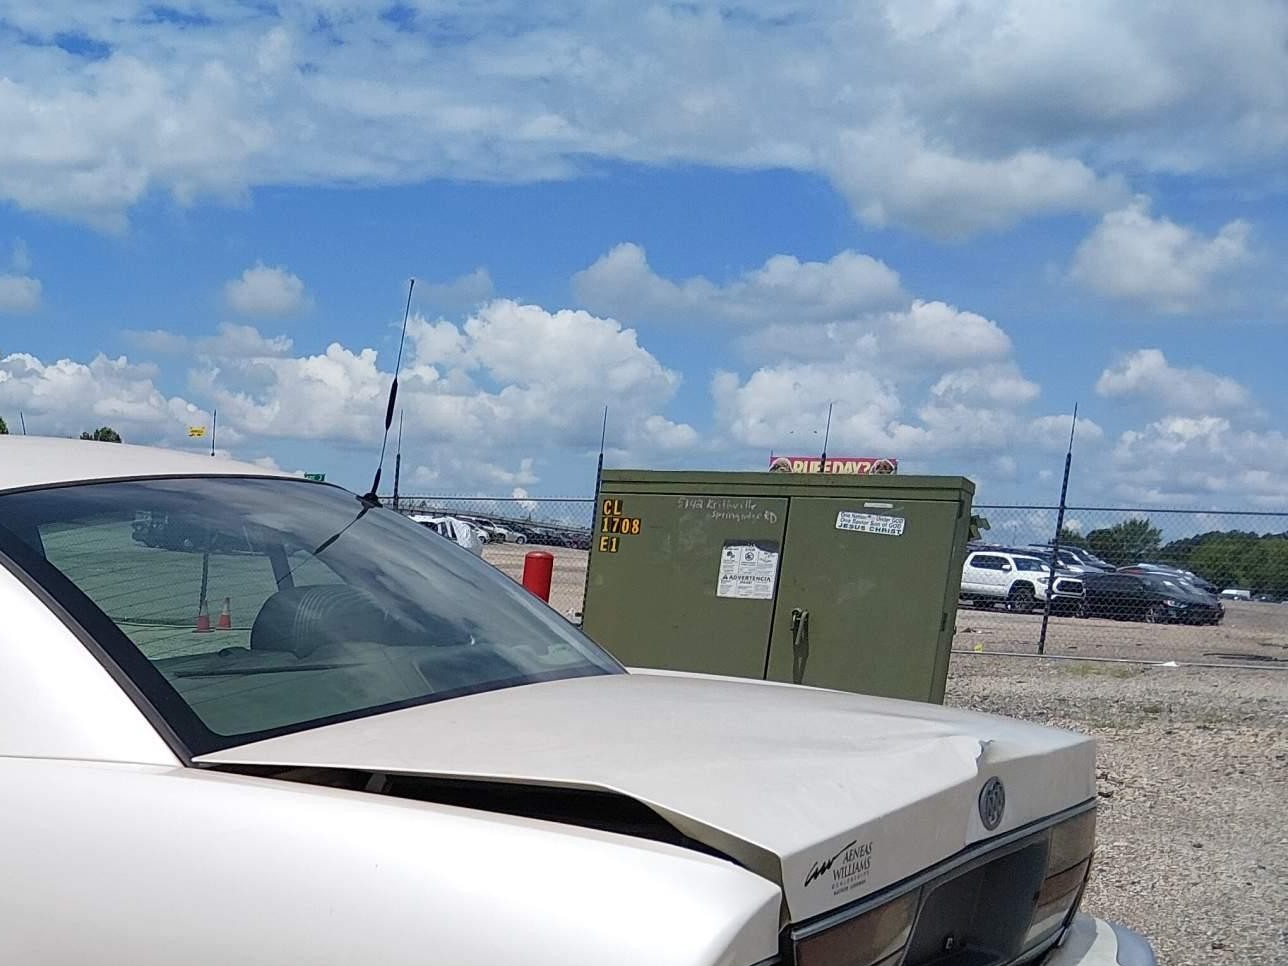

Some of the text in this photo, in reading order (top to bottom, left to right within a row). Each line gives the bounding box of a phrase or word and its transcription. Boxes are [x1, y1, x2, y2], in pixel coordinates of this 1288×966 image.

[603, 500, 621, 515] CL
[602, 517, 640, 534] 1708
[600, 536, 617, 552] E1
[843, 842, 873, 865] AENEAS
[833, 856, 871, 881] WILLIAMS
